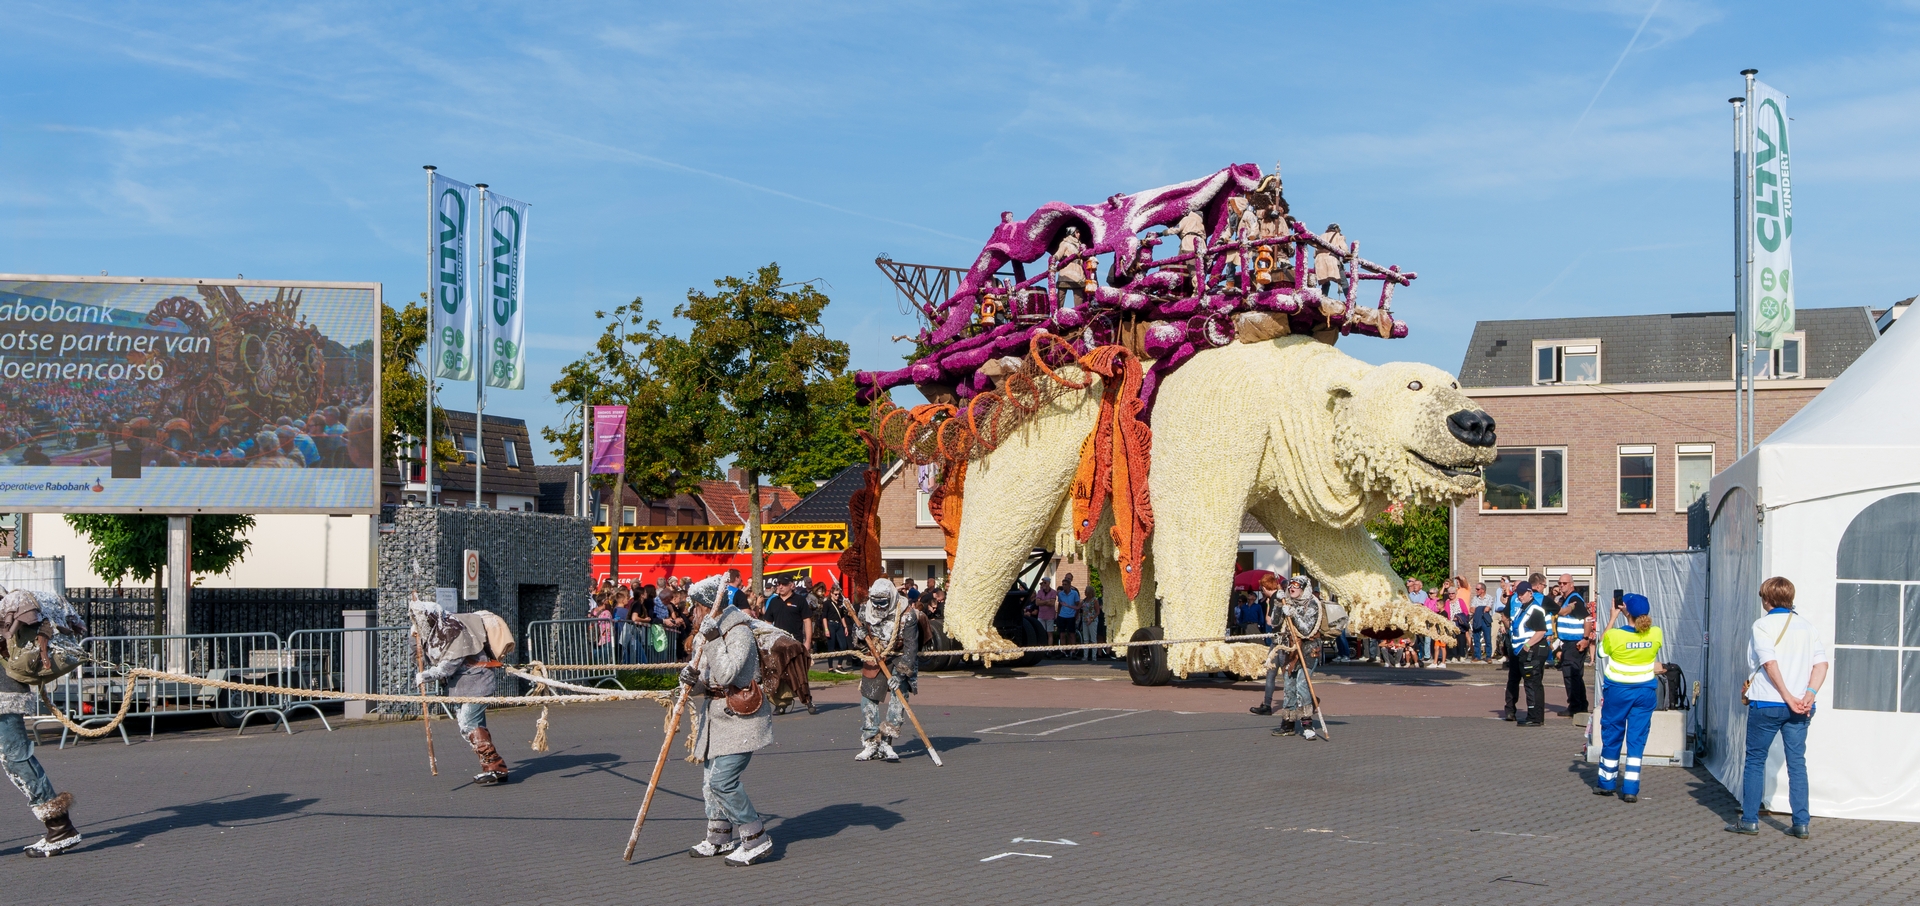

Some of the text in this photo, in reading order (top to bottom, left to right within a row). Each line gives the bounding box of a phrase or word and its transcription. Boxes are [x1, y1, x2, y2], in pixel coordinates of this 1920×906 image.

[1756, 127, 1781, 253] CLTV
[1781, 151, 1792, 218] ZUNDERT
[440, 210, 458, 315] CLTV
[493, 227, 511, 327] CLTV
[0, 298, 115, 322] abobank
[59, 331, 159, 356] partner
[165, 335, 211, 354] van
[45, 481, 90, 491] Rabobank
